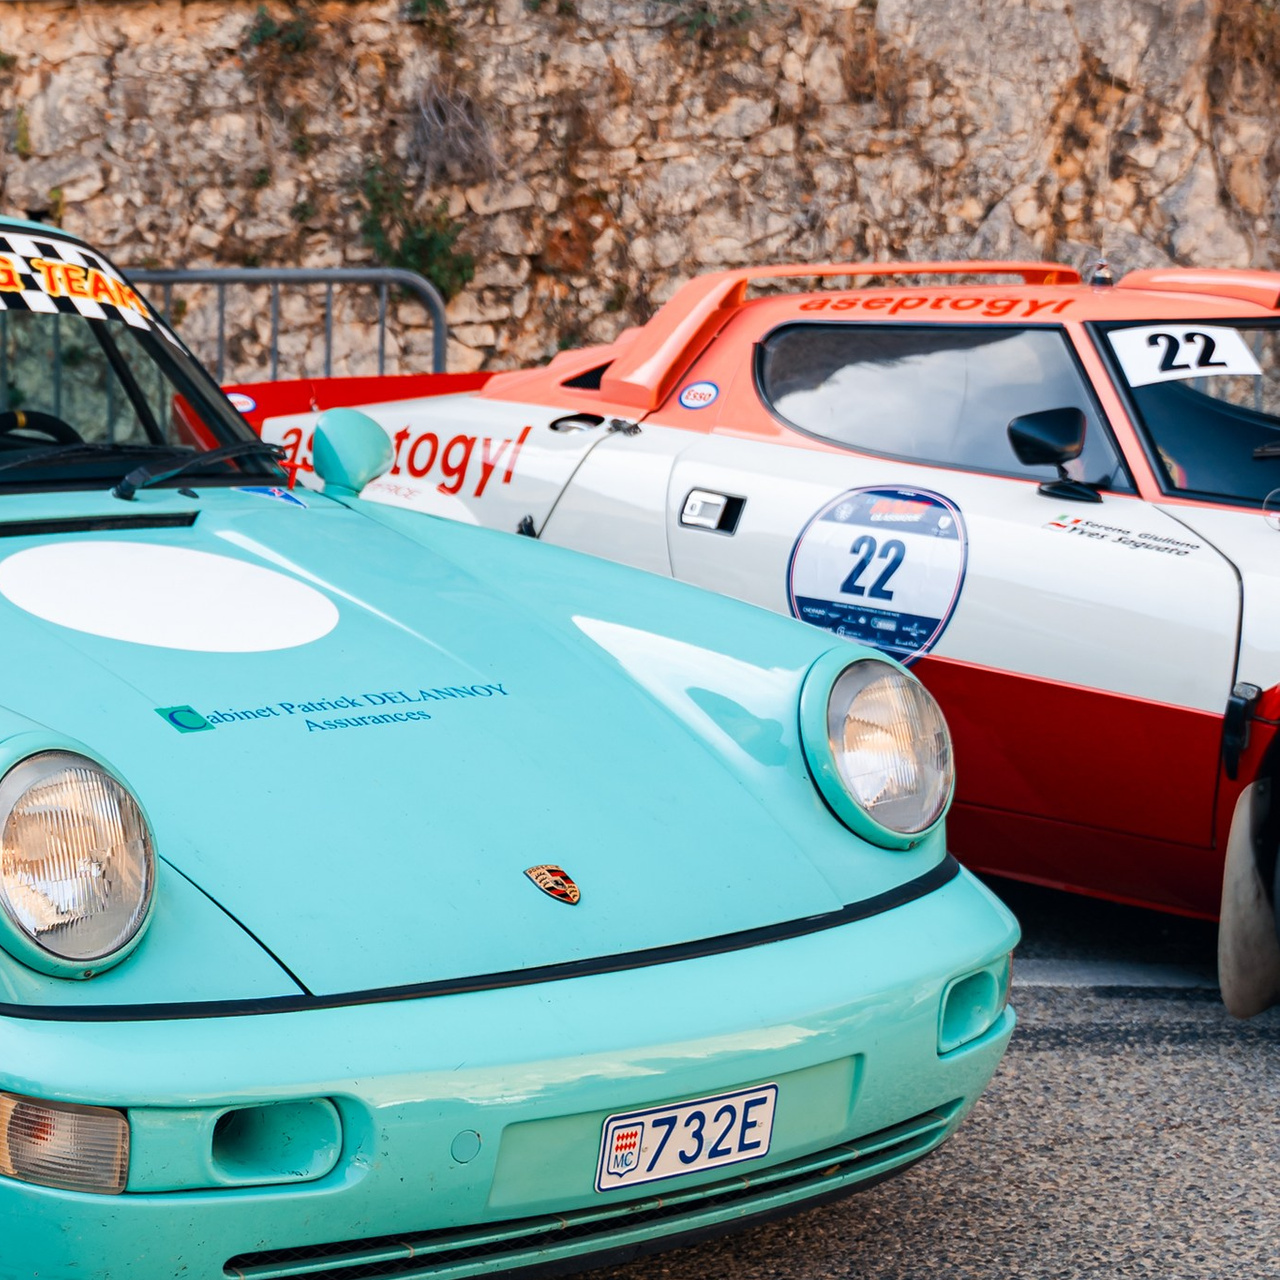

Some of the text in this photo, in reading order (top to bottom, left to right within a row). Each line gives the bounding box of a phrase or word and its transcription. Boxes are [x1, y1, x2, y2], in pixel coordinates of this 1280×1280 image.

[31, 258, 151, 319] TEAM
[799, 295, 1076, 318] aseptogyl
[1147, 331, 1229, 373] 22
[839, 534, 907, 602] 22
[167, 683, 510, 732] Cabinet Patrick DELANNOY
[305, 708, 432, 733] Assurances
[613, 1096, 768, 1173] MC 732E
